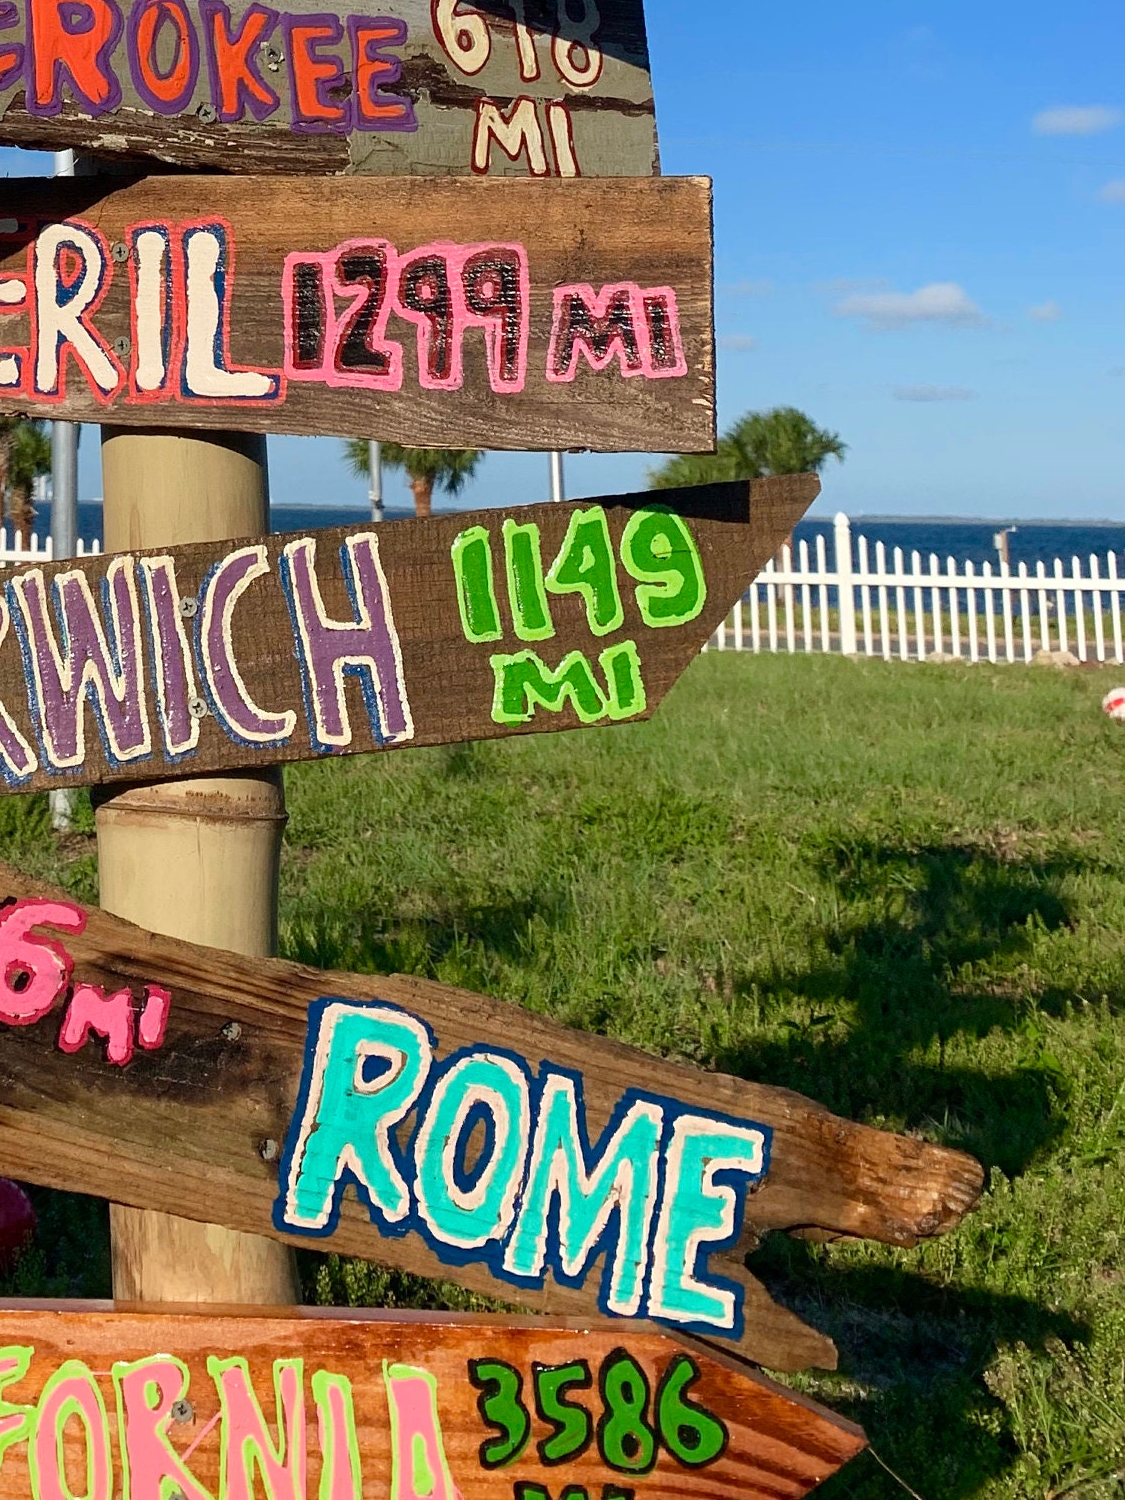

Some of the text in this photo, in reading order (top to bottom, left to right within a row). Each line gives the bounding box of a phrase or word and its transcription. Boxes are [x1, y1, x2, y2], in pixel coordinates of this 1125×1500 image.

[471, 95, 582, 178] MI
[281, 238, 530, 394] 1299
[546, 281, 688, 383] MI
[450, 504, 707, 644] 1149
[489, 639, 648, 727] MI
[58, 983, 173, 1067] MI
[272, 995, 774, 1342] ROME
[467, 1346, 731, 1478] 3586
